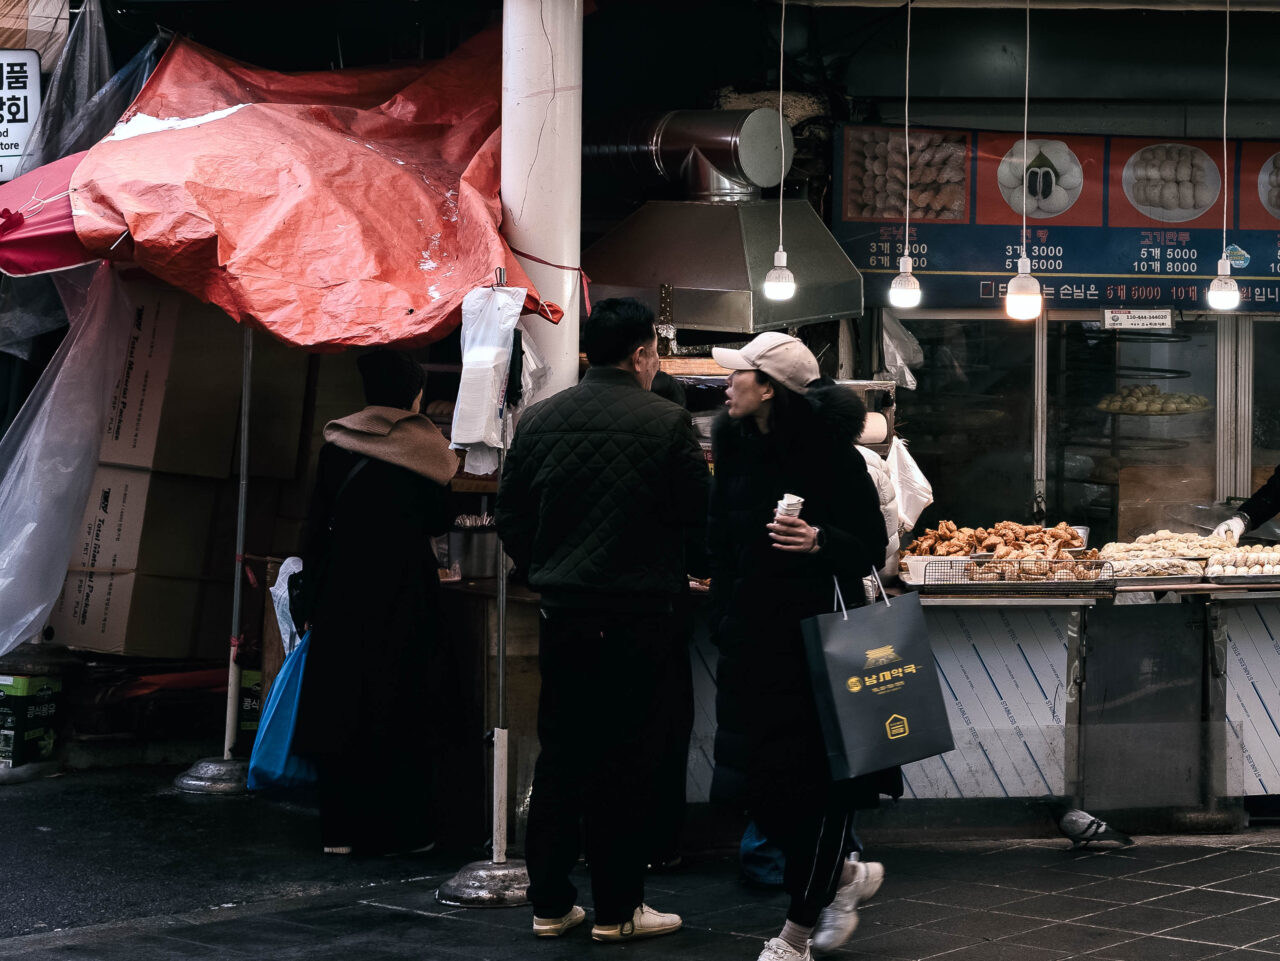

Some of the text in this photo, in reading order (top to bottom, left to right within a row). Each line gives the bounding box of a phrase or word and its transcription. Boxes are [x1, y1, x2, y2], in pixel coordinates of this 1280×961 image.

[1140, 231, 1190, 246] 고기만두
[869, 242, 890, 254] 3개
[1032, 246, 1063, 257] 3000
[1140, 248, 1198, 260] 5개 5000
[869, 255, 927, 268] 6개 500
[1032, 259, 1063, 270] 5000
[1133, 261, 1198, 273] 10개 8000
[1060, 284, 1099, 299] 손님은
[128, 335, 139, 358] Total
[122, 360, 135, 399] Material
[114, 401, 127, 440] Package
[94, 518, 105, 542] Total
[88, 542, 101, 582] Mateal
[81, 584, 94, 626] Package
